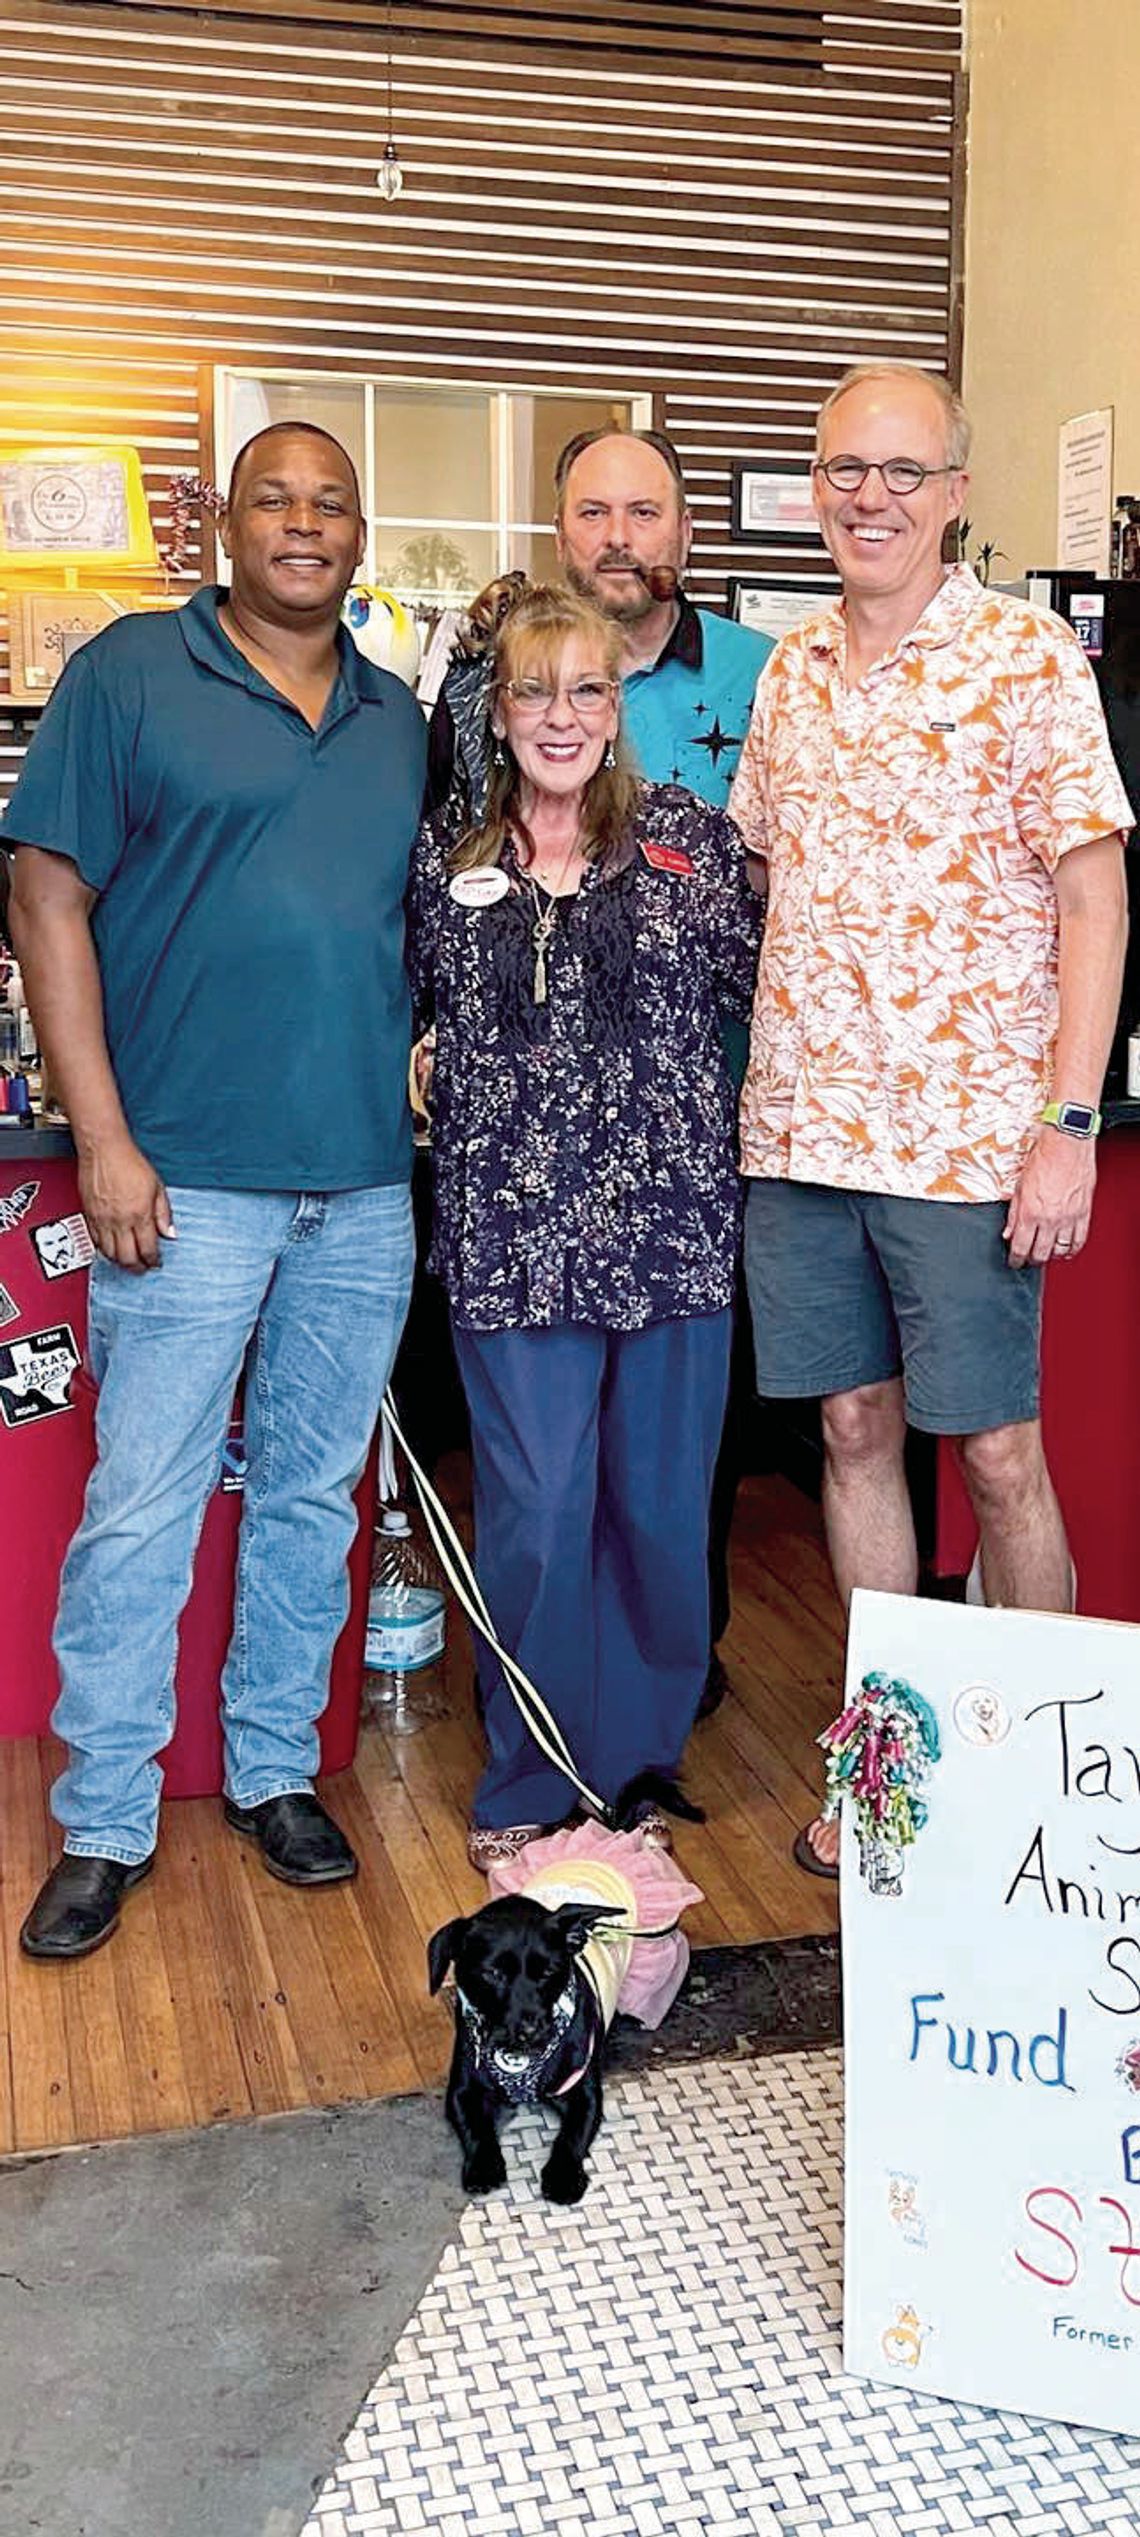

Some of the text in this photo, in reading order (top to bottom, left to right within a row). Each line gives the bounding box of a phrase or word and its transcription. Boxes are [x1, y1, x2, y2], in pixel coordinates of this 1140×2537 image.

[19, 1352, 68, 1373] TEXAS
[910, 1991, 1077, 2093] Fund
[1053, 2315, 1134, 2351] Former
